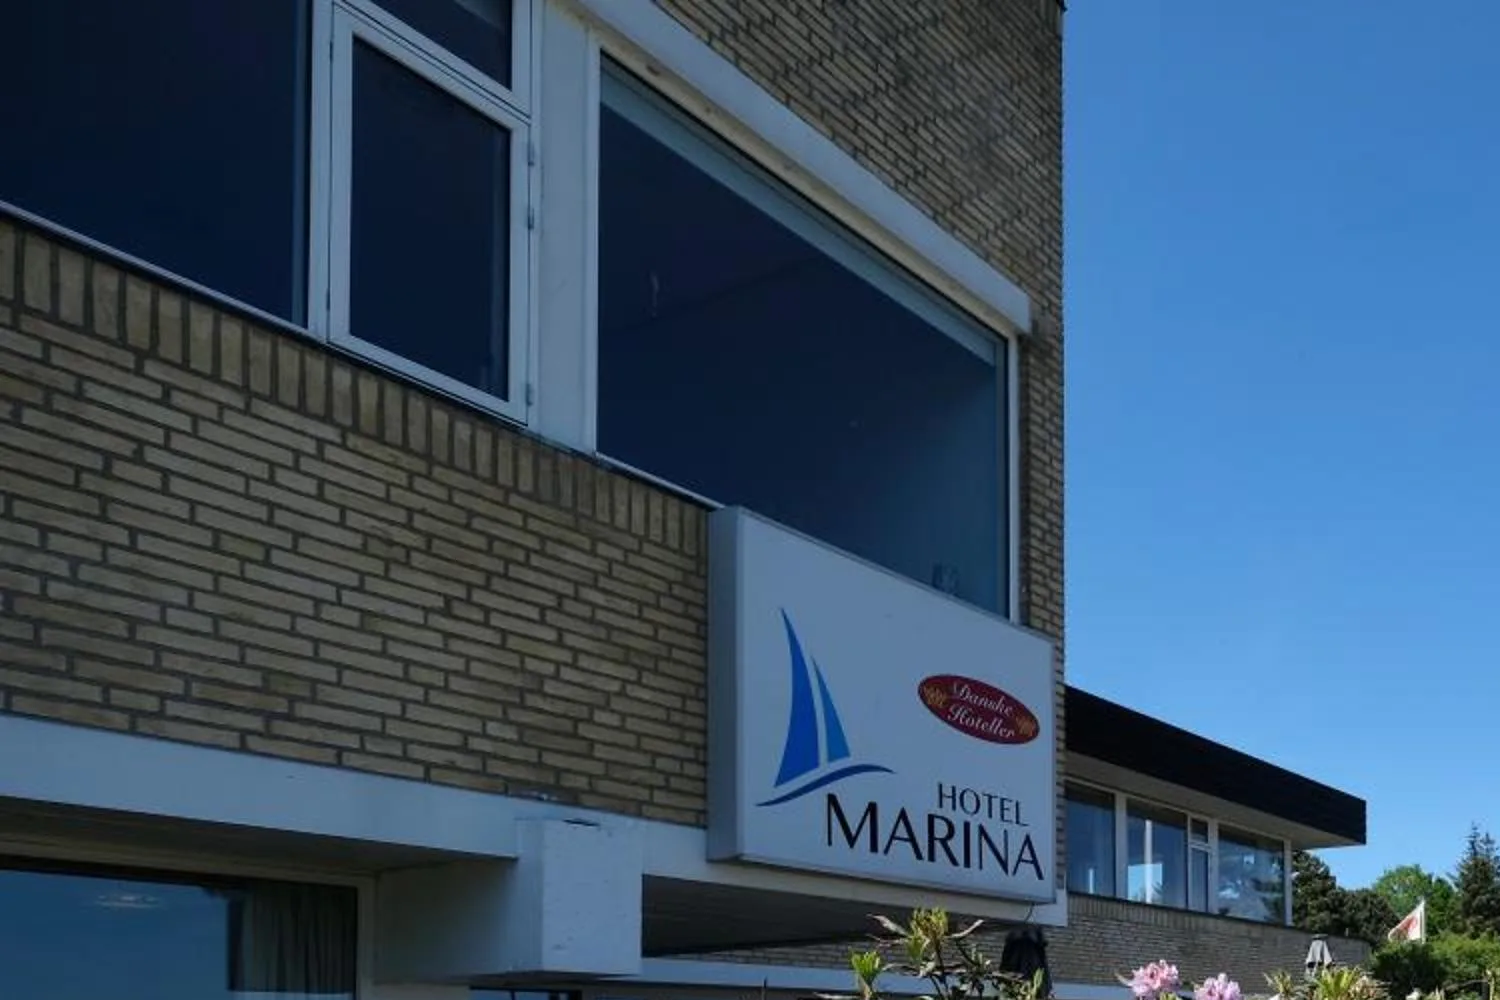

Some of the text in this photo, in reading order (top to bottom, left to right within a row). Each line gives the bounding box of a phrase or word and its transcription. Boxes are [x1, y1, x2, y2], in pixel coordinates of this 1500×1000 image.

[947, 703, 1016, 739] Hoteller
[936, 782, 1029, 827] HOTEL
[827, 793, 1045, 880] MARINA
